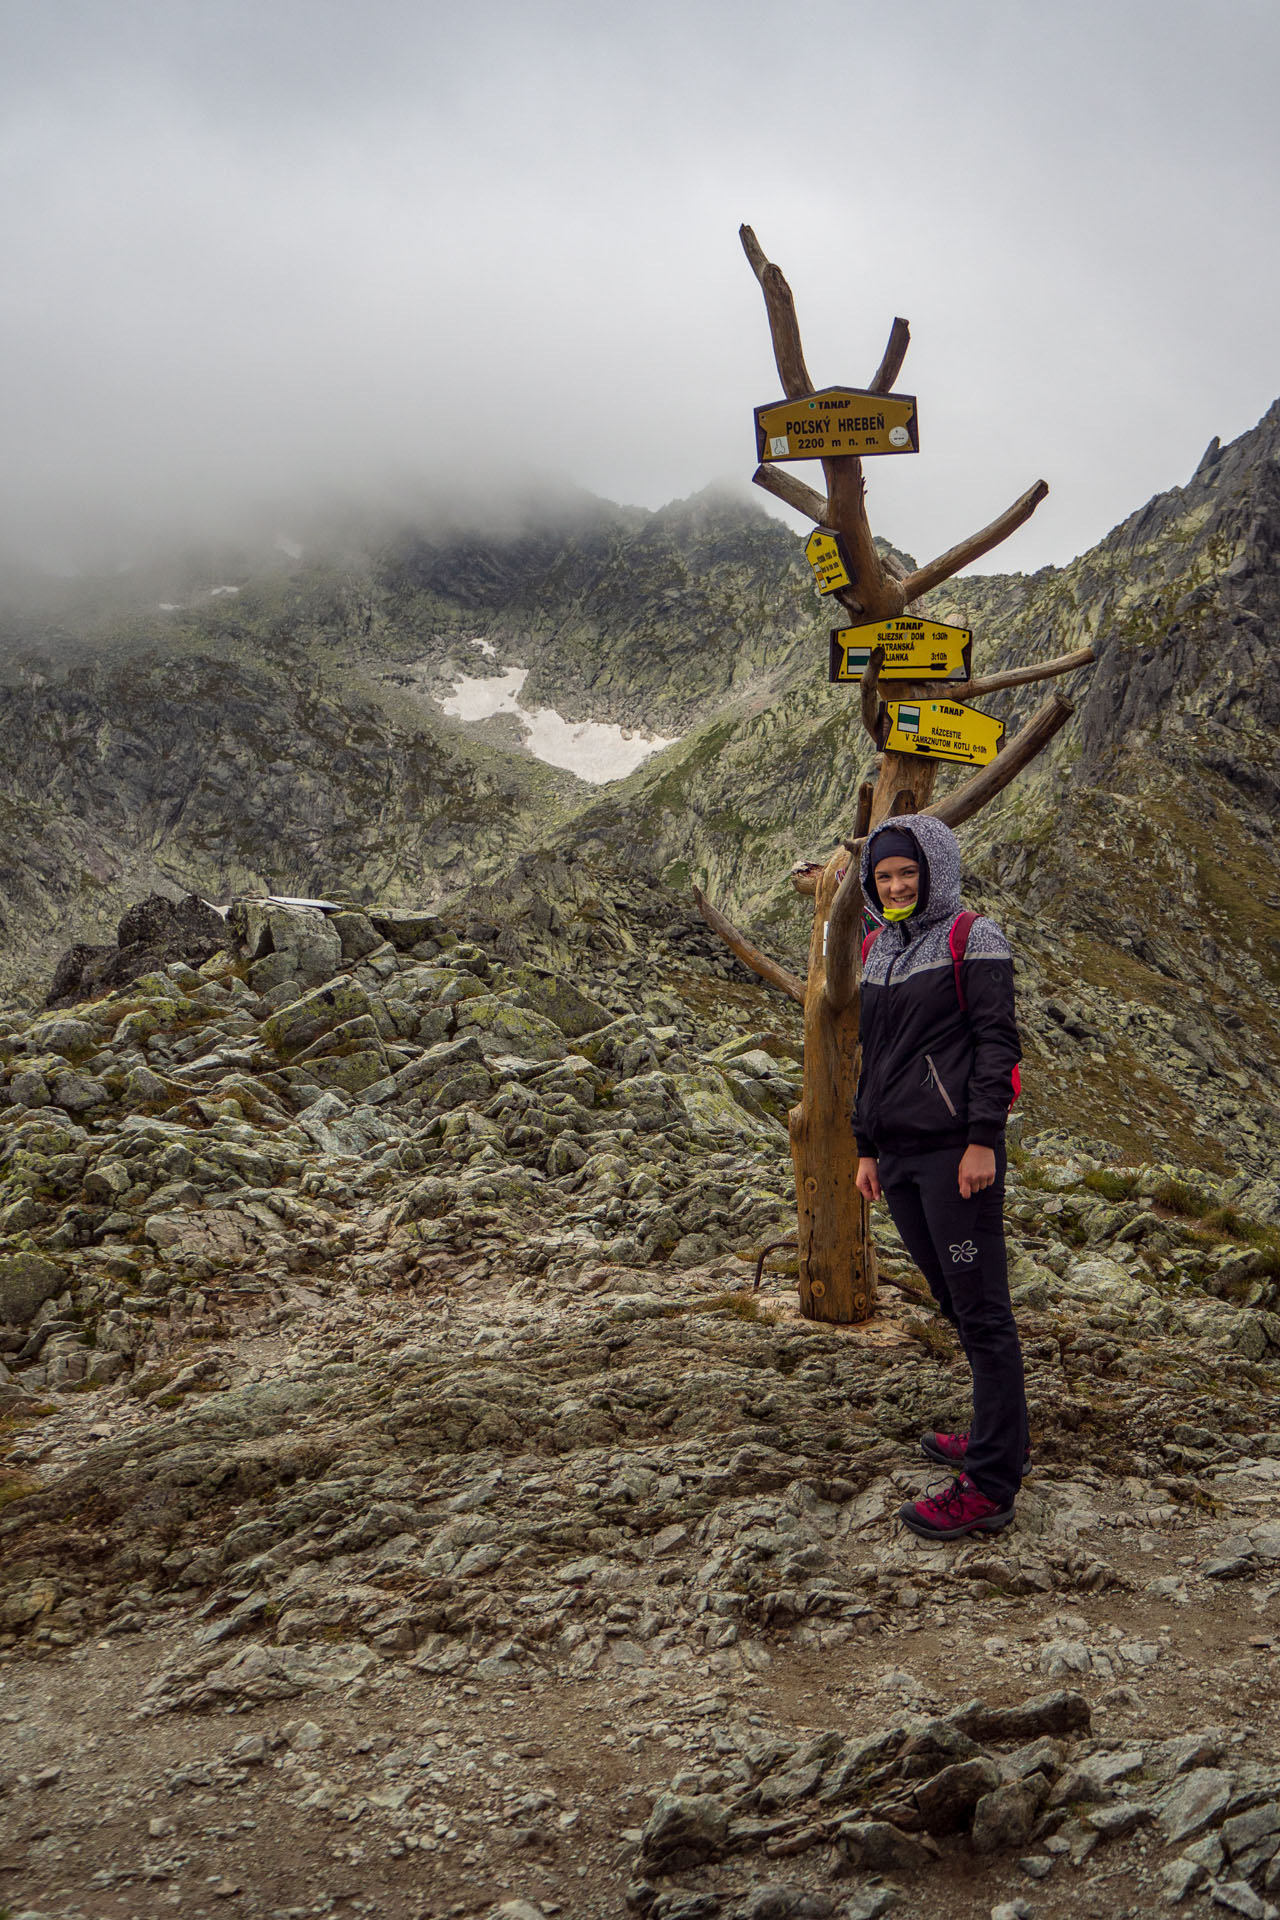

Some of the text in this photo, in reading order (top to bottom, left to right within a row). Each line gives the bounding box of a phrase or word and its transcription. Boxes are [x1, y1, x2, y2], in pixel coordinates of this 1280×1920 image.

[818, 400, 851, 410] TANAP
[786, 412, 885, 435] POĽSKÝ HREBEŇ
[798, 436, 879, 449] 2200 m n. m.
[895, 622, 923, 630] TANAP
[877, 632, 909, 640] SLIEZSK
[911, 632, 925, 640] DOM
[931, 652, 947, 660] 3:10h
[940, 705, 965, 716] TANAP
[932, 726, 962, 739] RÁZCESTIE
[905, 733, 910, 741] V
[912, 735, 951, 747] ZAMRZNUTOM
[954, 742, 970, 751] KOTLI
